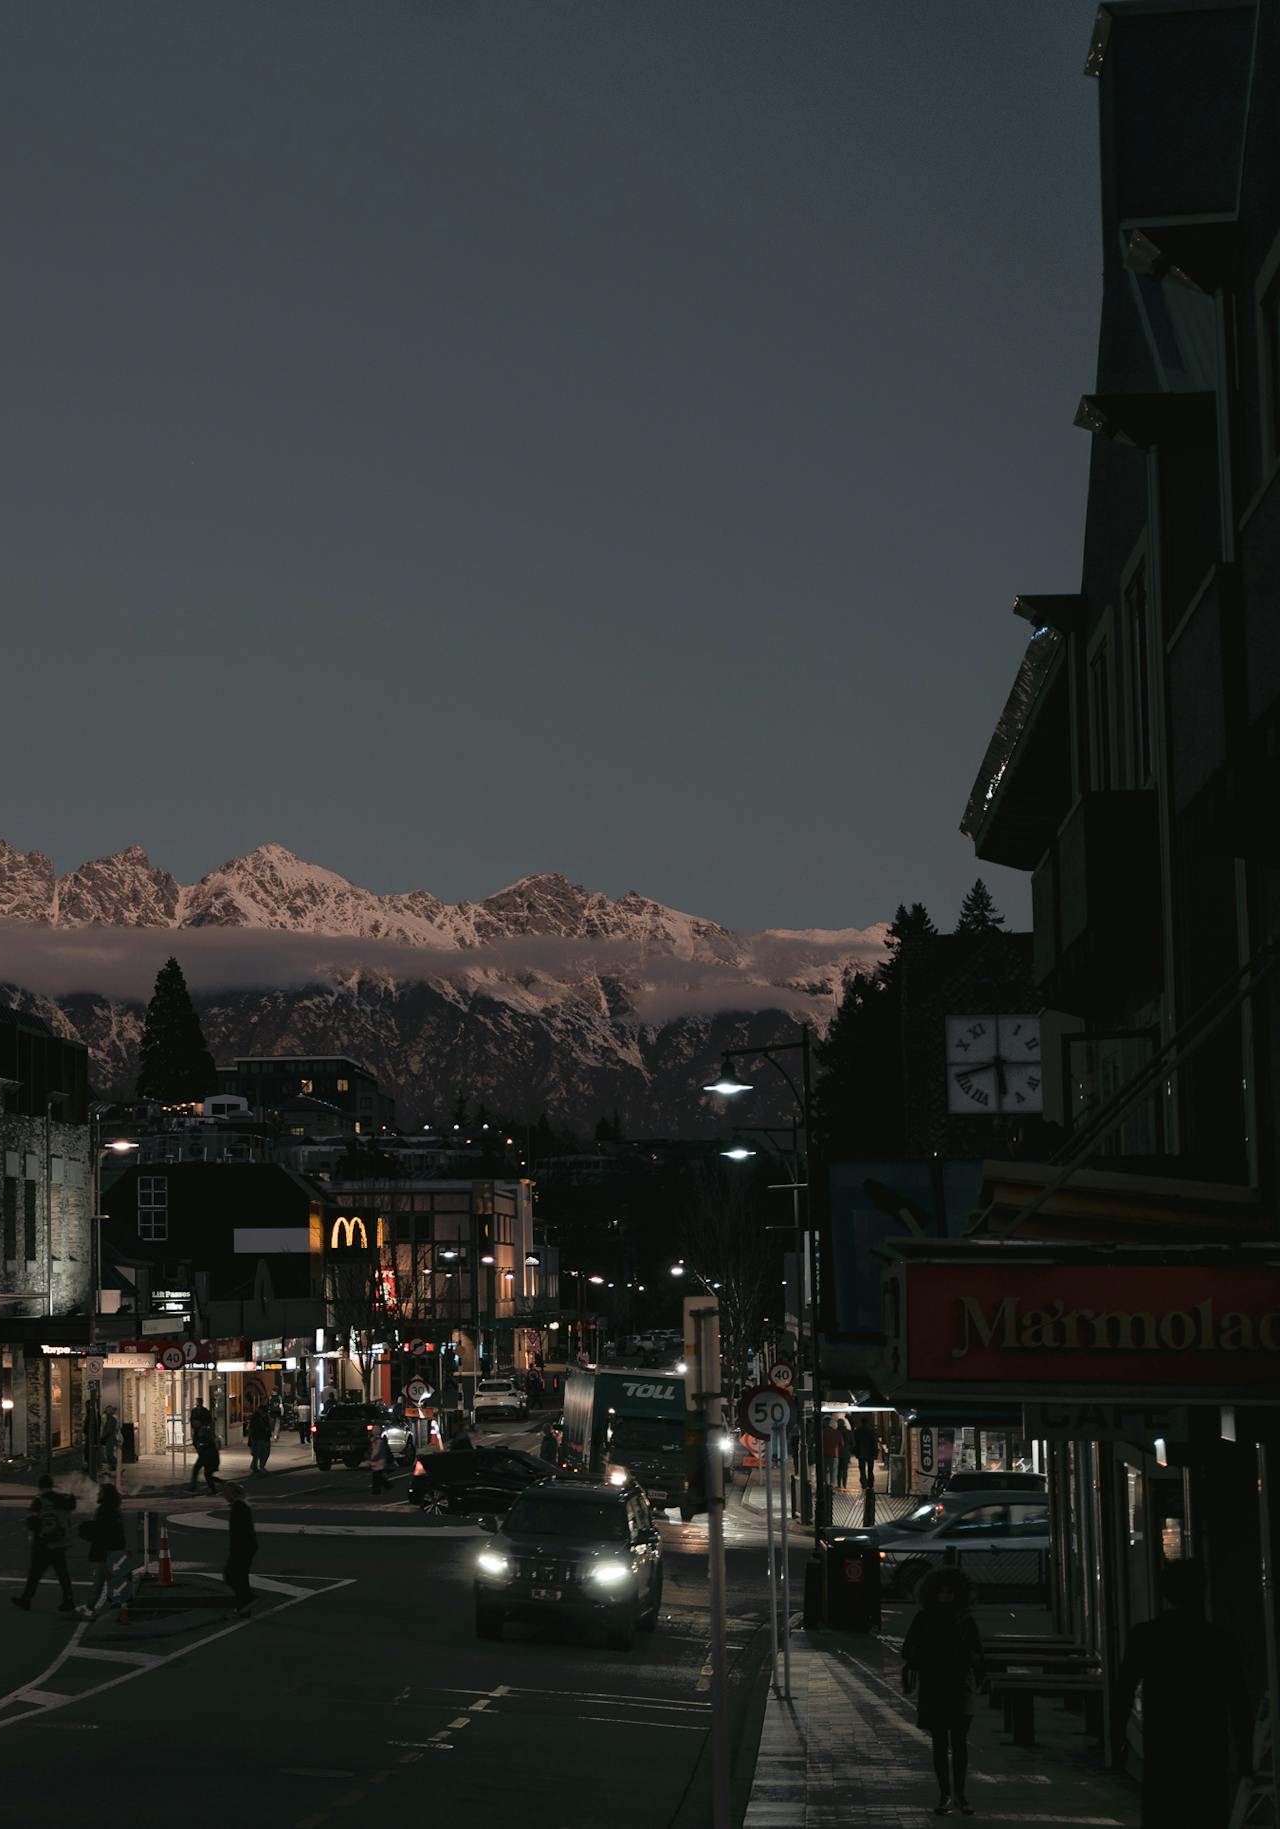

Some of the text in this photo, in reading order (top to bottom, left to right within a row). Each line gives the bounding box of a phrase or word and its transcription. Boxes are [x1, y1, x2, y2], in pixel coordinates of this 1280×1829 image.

[165, 1290, 191, 1298] Passes
[166, 1353, 180, 1364] 40
[774, 1370, 790, 1380] 40
[622, 1382, 675, 1400] TOLL
[754, 1403, 784, 1423] 50
